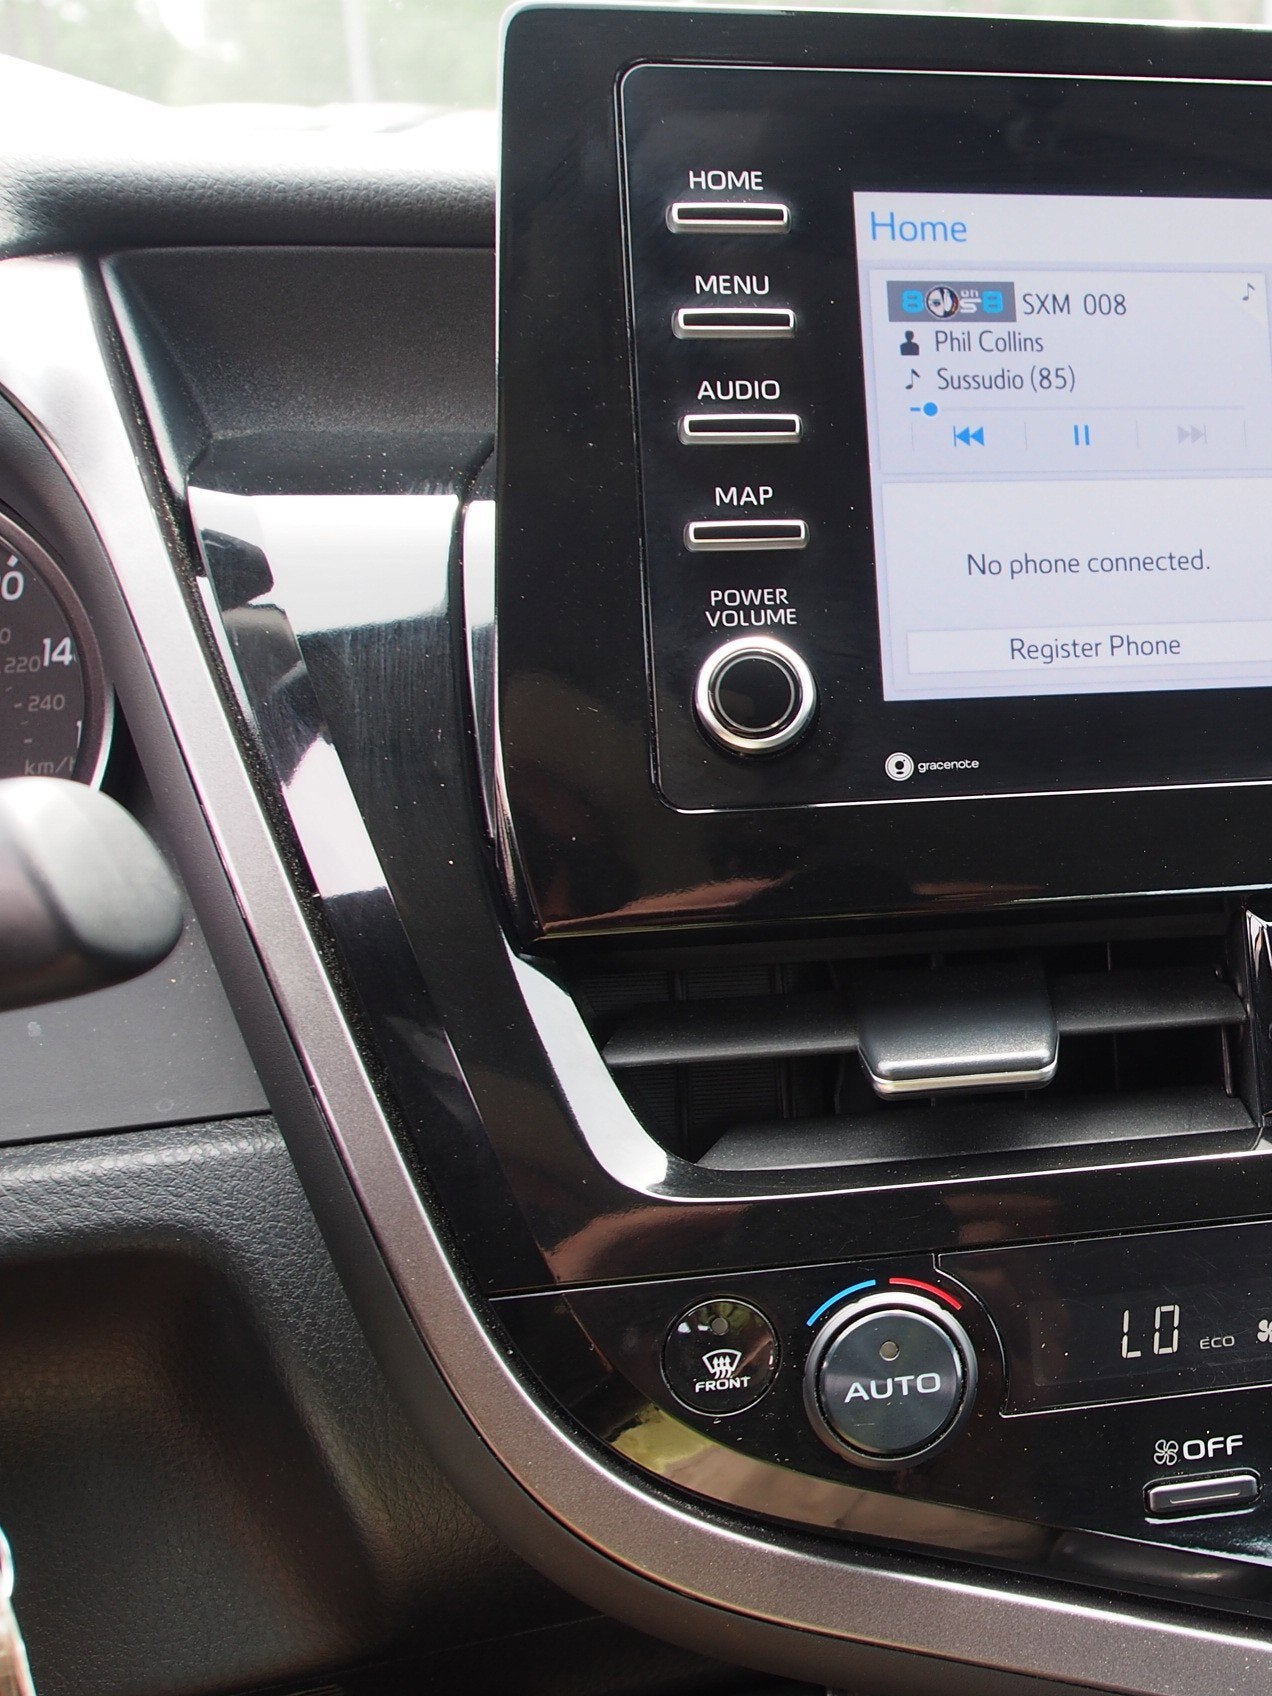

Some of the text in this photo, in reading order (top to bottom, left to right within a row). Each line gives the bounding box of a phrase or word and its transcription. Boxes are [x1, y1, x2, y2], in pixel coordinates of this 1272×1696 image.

[689, 170, 764, 190] HOME
[870, 211, 967, 242] Home
[695, 275, 770, 295] MENU
[1022, 293, 1128, 317] SXM 008
[935, 329, 1044, 352] Phil Collins
[937, 365, 1076, 393] Sussudio (85)
[697, 379, 781, 400] AUDIO
[714, 486, 774, 506] MAP
[967, 549, 1211, 579] No phone connected.
[710, 588, 790, 606] POWER
[705, 608, 797, 627] VOLUME
[42, 636, 73, 667] 14
[1010, 634, 1181, 664] Register Phone
[4, 656, 41, 674] 220
[28, 694, 65, 712] 240
[917, 757, 980, 773] gracenote
[1199, 1335, 1235, 1350] ECO
[695, 1376, 750, 1393] FRONT
[844, 1372, 942, 1403] AUTO
[1182, 1434, 1243, 1461] OFF
